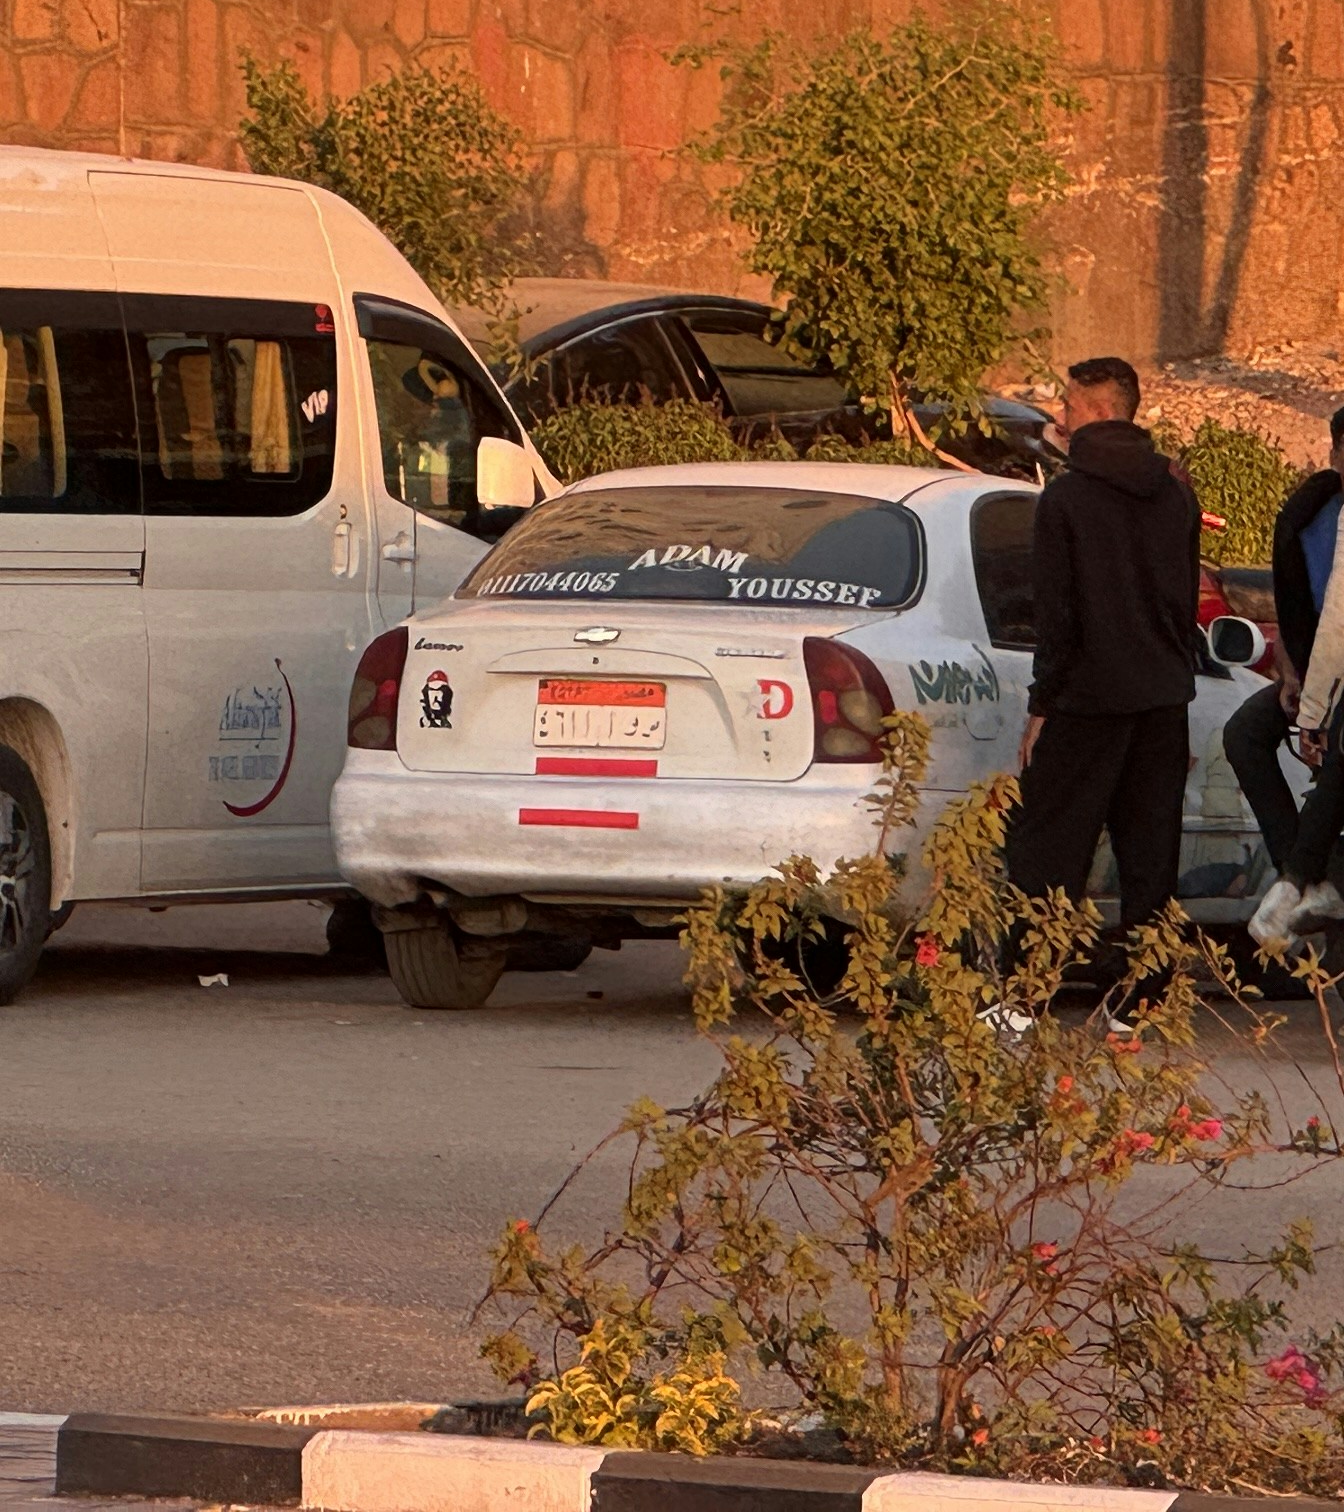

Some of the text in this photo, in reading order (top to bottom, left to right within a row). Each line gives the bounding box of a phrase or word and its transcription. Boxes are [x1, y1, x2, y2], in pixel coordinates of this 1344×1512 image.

[301, 389, 329, 424] VIP
[628, 544, 749, 575] ADAM
[728, 577, 882, 608] YOUSSEF
